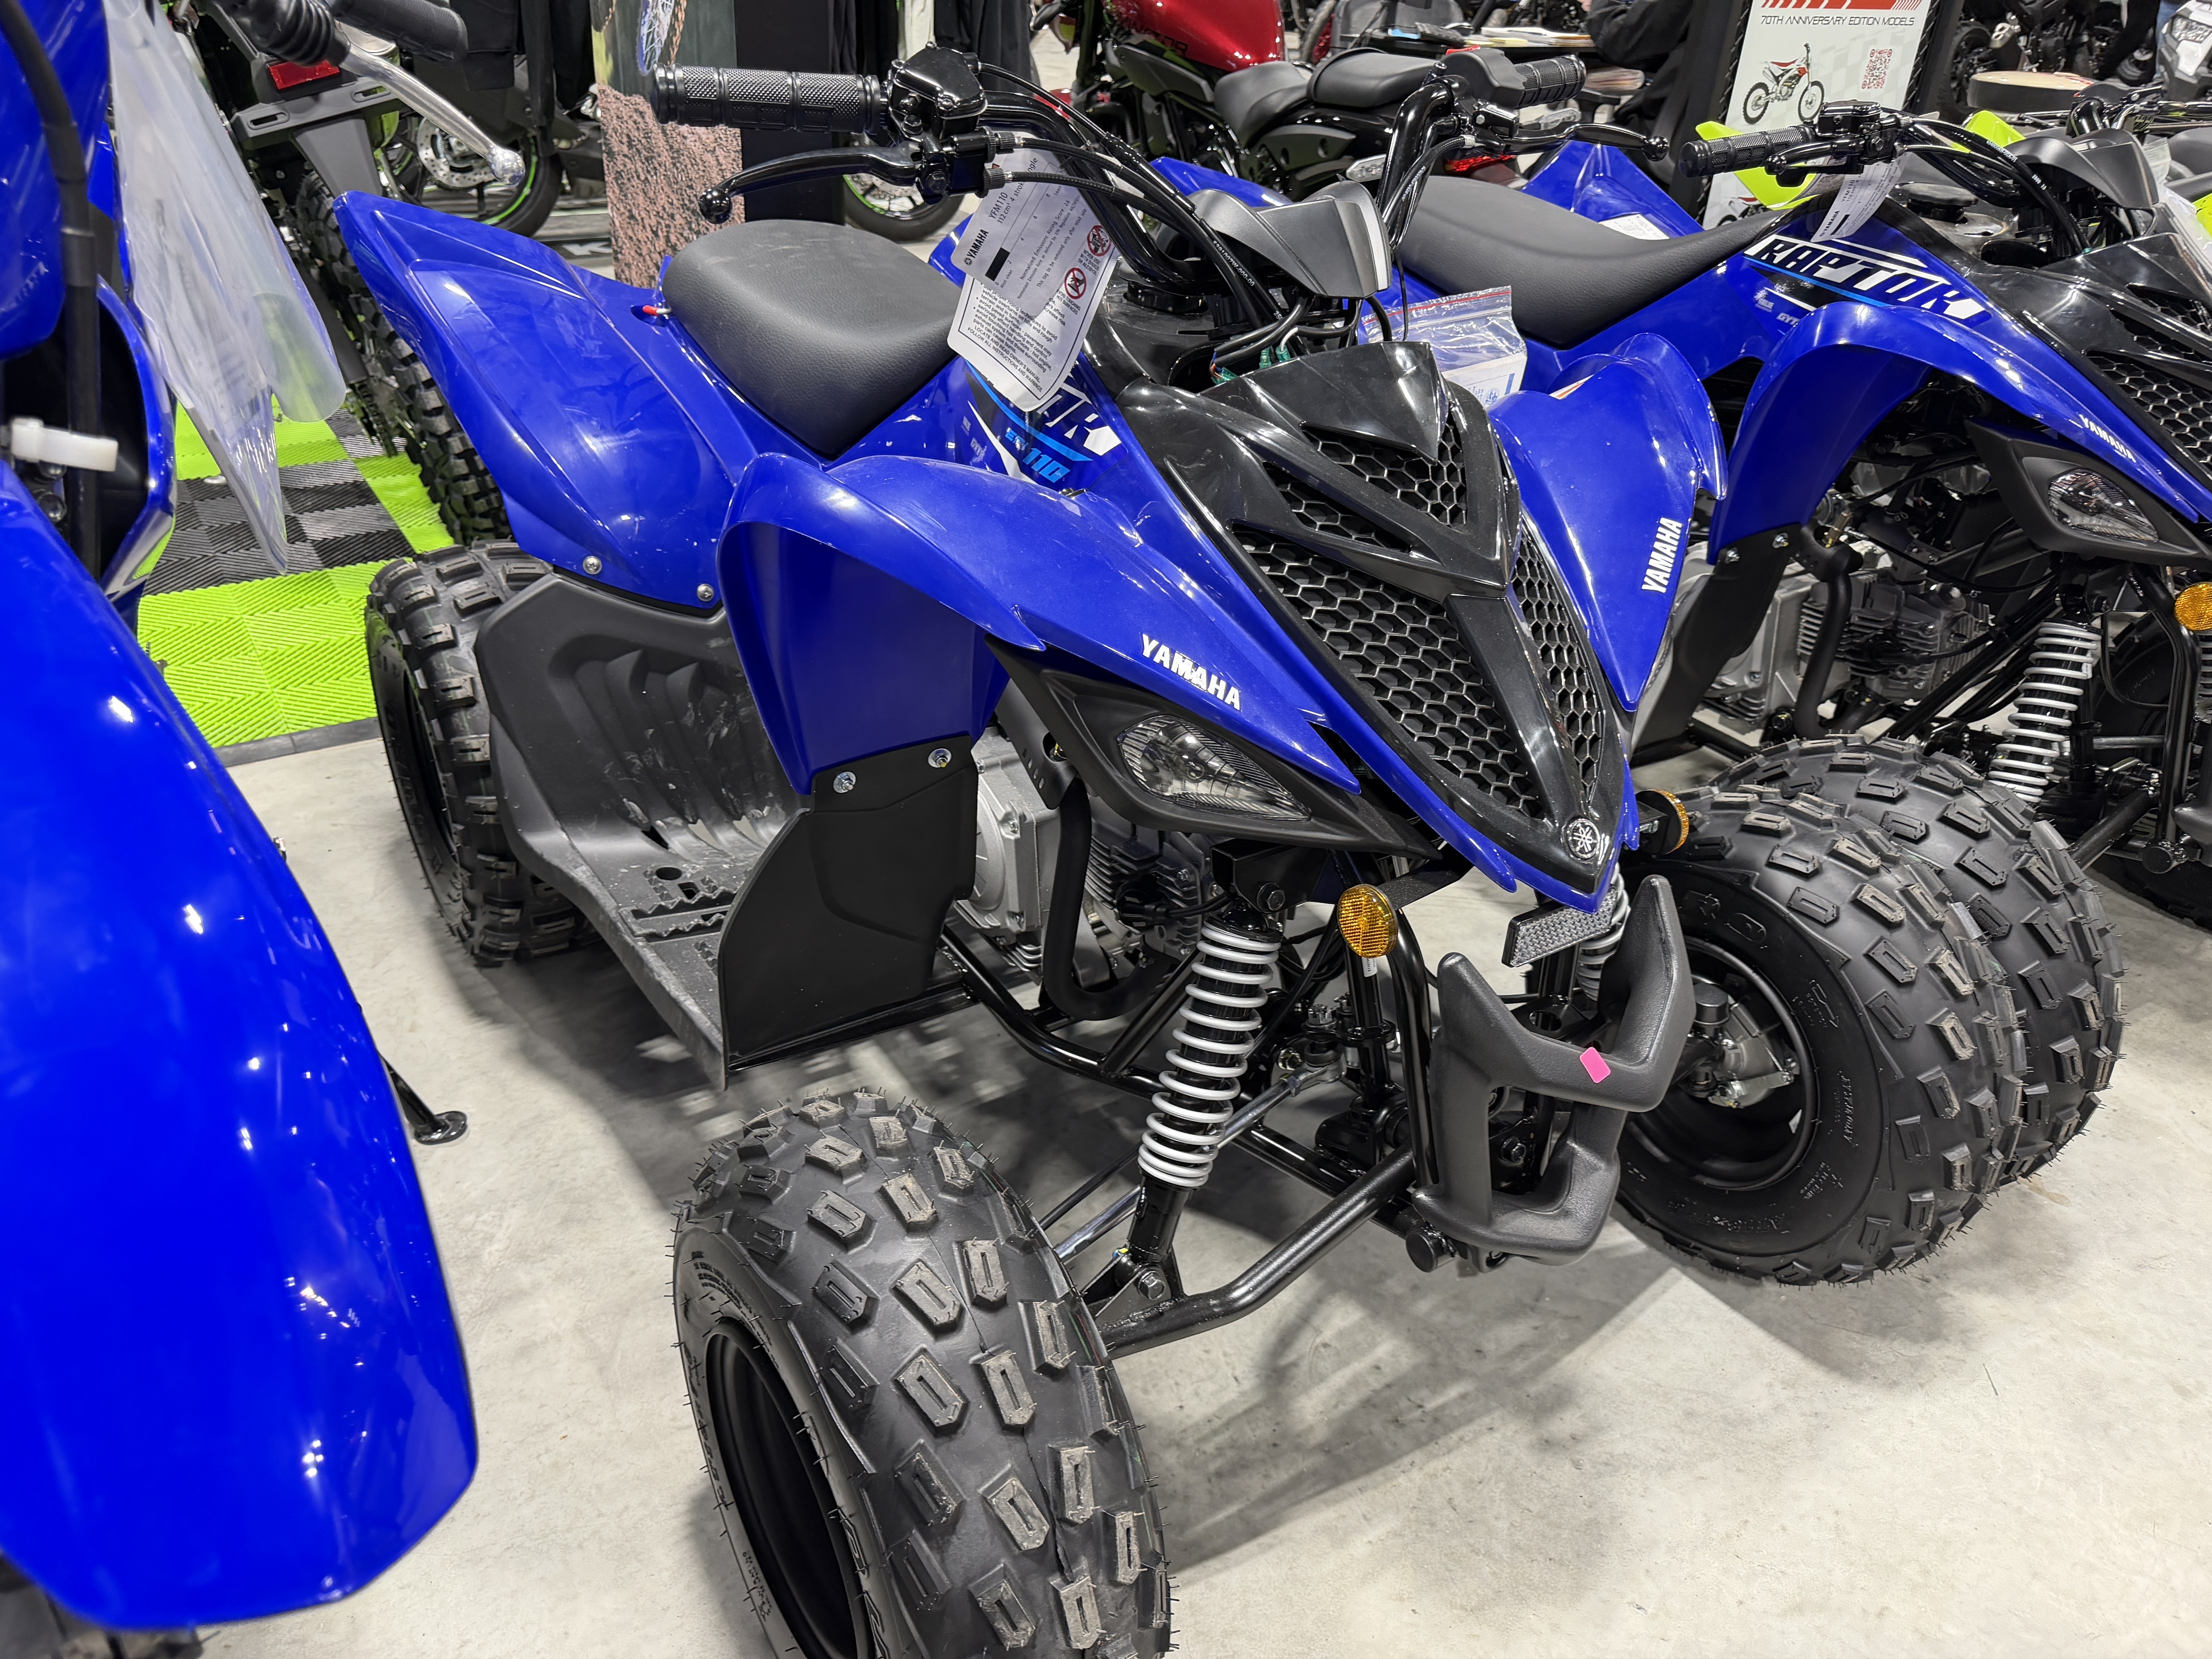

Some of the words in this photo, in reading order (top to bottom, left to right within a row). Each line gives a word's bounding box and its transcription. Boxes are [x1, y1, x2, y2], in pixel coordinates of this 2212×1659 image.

[1760, 15, 1784, 25] 70TH
[1785, 15, 1848, 26] ANNIVERSARY
[1848, 16, 1881, 26] EDITION
[1881, 17, 1915, 26] MODELS
[988, 191, 1008, 220] YFM110
[997, 214, 1006, 224] 112
[1013, 180, 1025, 196] strok
[1026, 156, 1039, 173] ngle
[966, 228, 989, 259] YAMAHA
[1019, 256, 1036, 280] Normalized
[1033, 235, 1048, 256] Emissions
[1046, 220, 1058, 235] Rating
[1055, 208, 1065, 220] Score
[1823, 210, 1840, 231] YAMAHA
[1752, 234, 1973, 318] RAPTOR
[980, 293, 996, 306] terrain
[995, 304, 1005, 312] and
[982, 288, 998, 301] vehicle
[998, 299, 1018, 316] overturns
[1032, 325, 1041, 333] and
[1039, 331, 1053, 344] rough
[1776, 312, 1800, 326] GYT
[967, 327, 984, 342] FOLLOW
[984, 340, 993, 348] ALL
[991, 345, 1019, 370] INSTRUCTIONS
[1017, 367, 1027, 376] AND
[972, 318, 985, 328] parts
[984, 326, 993, 335] can
[992, 332, 1005, 343] cause
[1004, 341, 1018, 354] burns.
[974, 313, 992, 327] exhaust
[991, 325, 1006, 339] system
[1005, 336, 1015, 344] and
[1013, 342, 1025, 354] those
[1024, 351, 1047, 373] surrounding
[974, 325, 991, 340] LOCATE
[990, 337, 1000, 346] AND
[998, 344, 1010, 355] READ
[1008, 352, 1027, 369] OWNER'S
[975, 308, 988, 318] avoid
[987, 316, 1006, 333] touching
[1005, 329, 1014, 338] hot
[1012, 335, 1030, 351] surfaces
[1031, 350, 1040, 359] hot
[977, 303, 997, 319] seriously
[996, 316, 1010, 328] affect
[1008, 325, 1027, 342] handling
[1025, 339, 1034, 348] and
[1033, 345, 1049, 360] control.
[979, 298, 992, 309] avoid
[990, 306, 1005, 318] paved
[1004, 316, 1022, 331] surfaces
[1023, 332, 1044, 349] pavement
[1042, 347, 1052, 357] may
[1045, 329, 1058, 340] avoid
[2078, 414, 2137, 463] YAMAHA
[1022, 448, 1070, 483] 110
[1641, 517, 1683, 594] YAMAHA
[1140, 633, 1243, 711] YAMAHA
